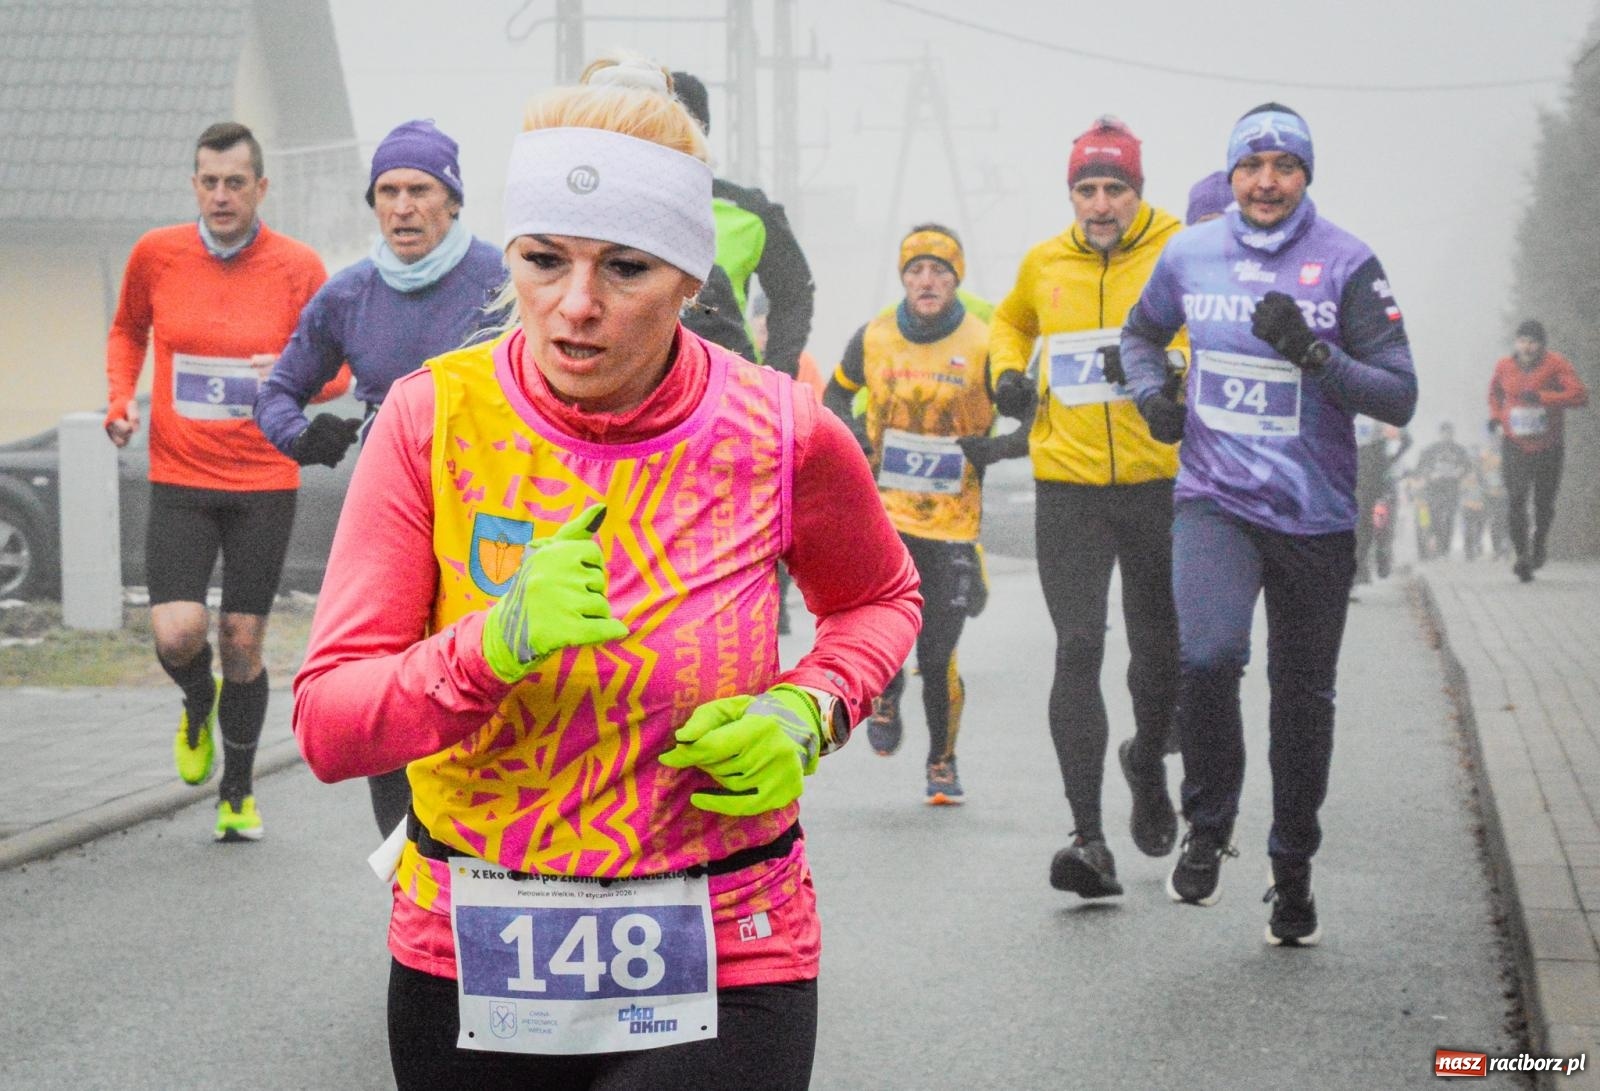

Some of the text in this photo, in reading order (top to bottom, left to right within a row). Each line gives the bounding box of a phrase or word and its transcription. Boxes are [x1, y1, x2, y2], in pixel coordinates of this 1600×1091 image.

[1182, 293, 1337, 329] RUNNRS
[1074, 352, 1106, 384] 7
[206, 377, 226, 404] 3
[1223, 378, 1269, 414] 94
[906, 452, 942, 477] 97
[471, 869, 481, 879] X
[482, 869, 505, 880] Eko
[615, 889, 633, 897] 2026
[499, 913, 666, 993] 148
